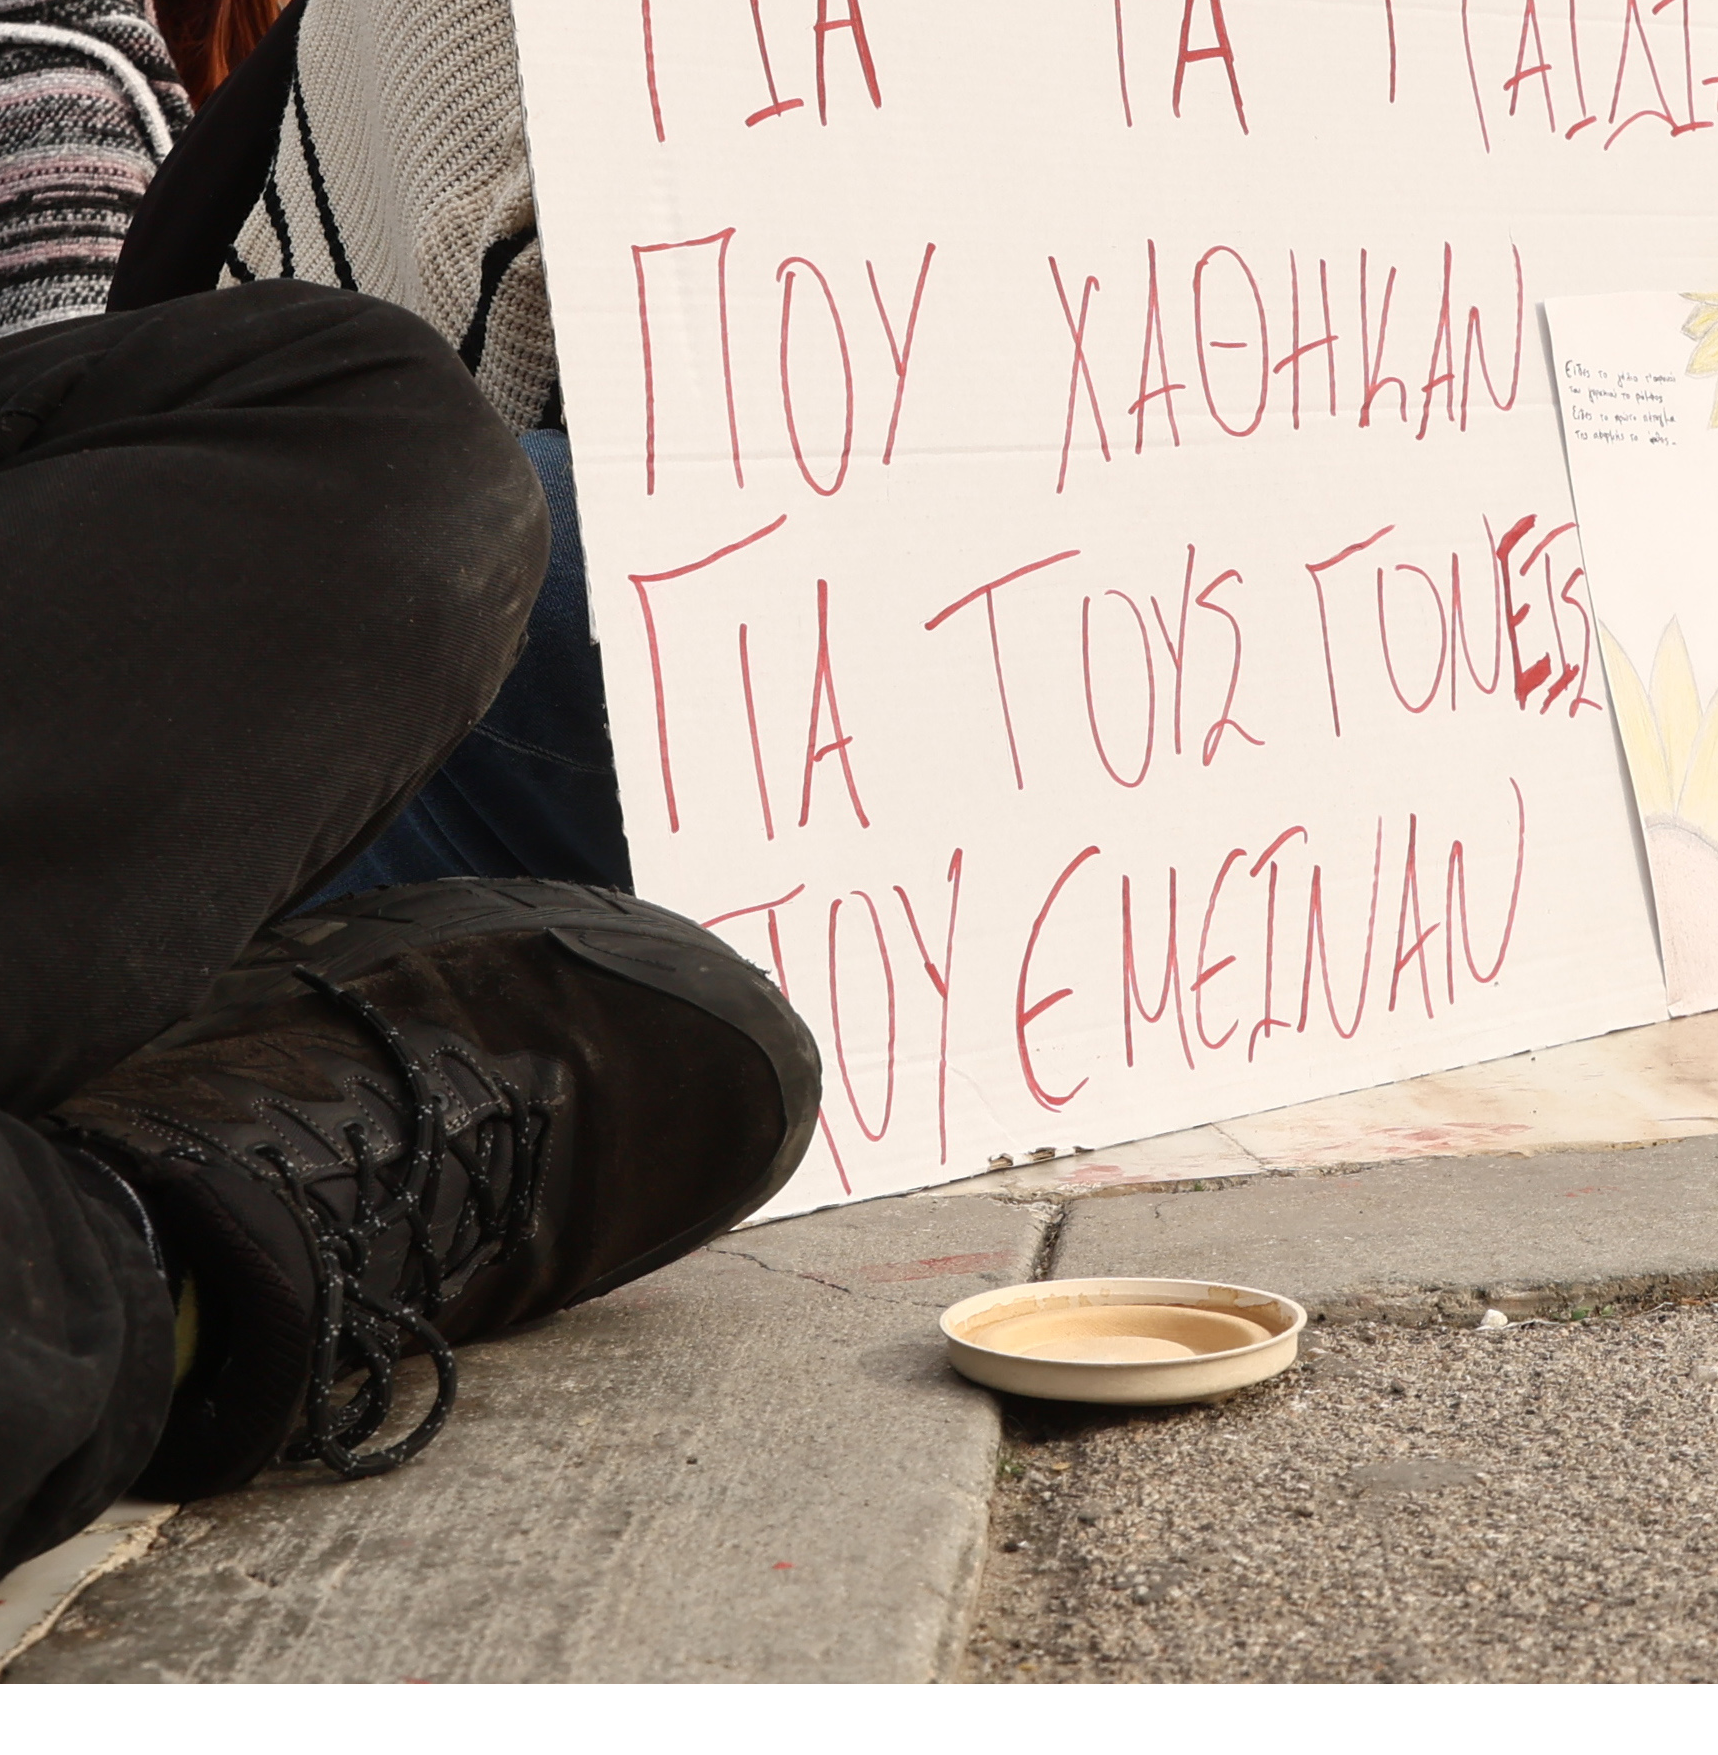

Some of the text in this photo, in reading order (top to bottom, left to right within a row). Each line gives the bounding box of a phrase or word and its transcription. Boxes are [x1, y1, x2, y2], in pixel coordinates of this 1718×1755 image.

[630, 227, 1524, 498] ΠΟΥ ΧΑΘΗΚΑΝ
[628, 512, 1604, 842] ΓΙΑ ΤΟΥΣ ΓΟΝΕΙΣ
[1015, 779, 1526, 1113] ΕΜΕΙΝΑΝ
